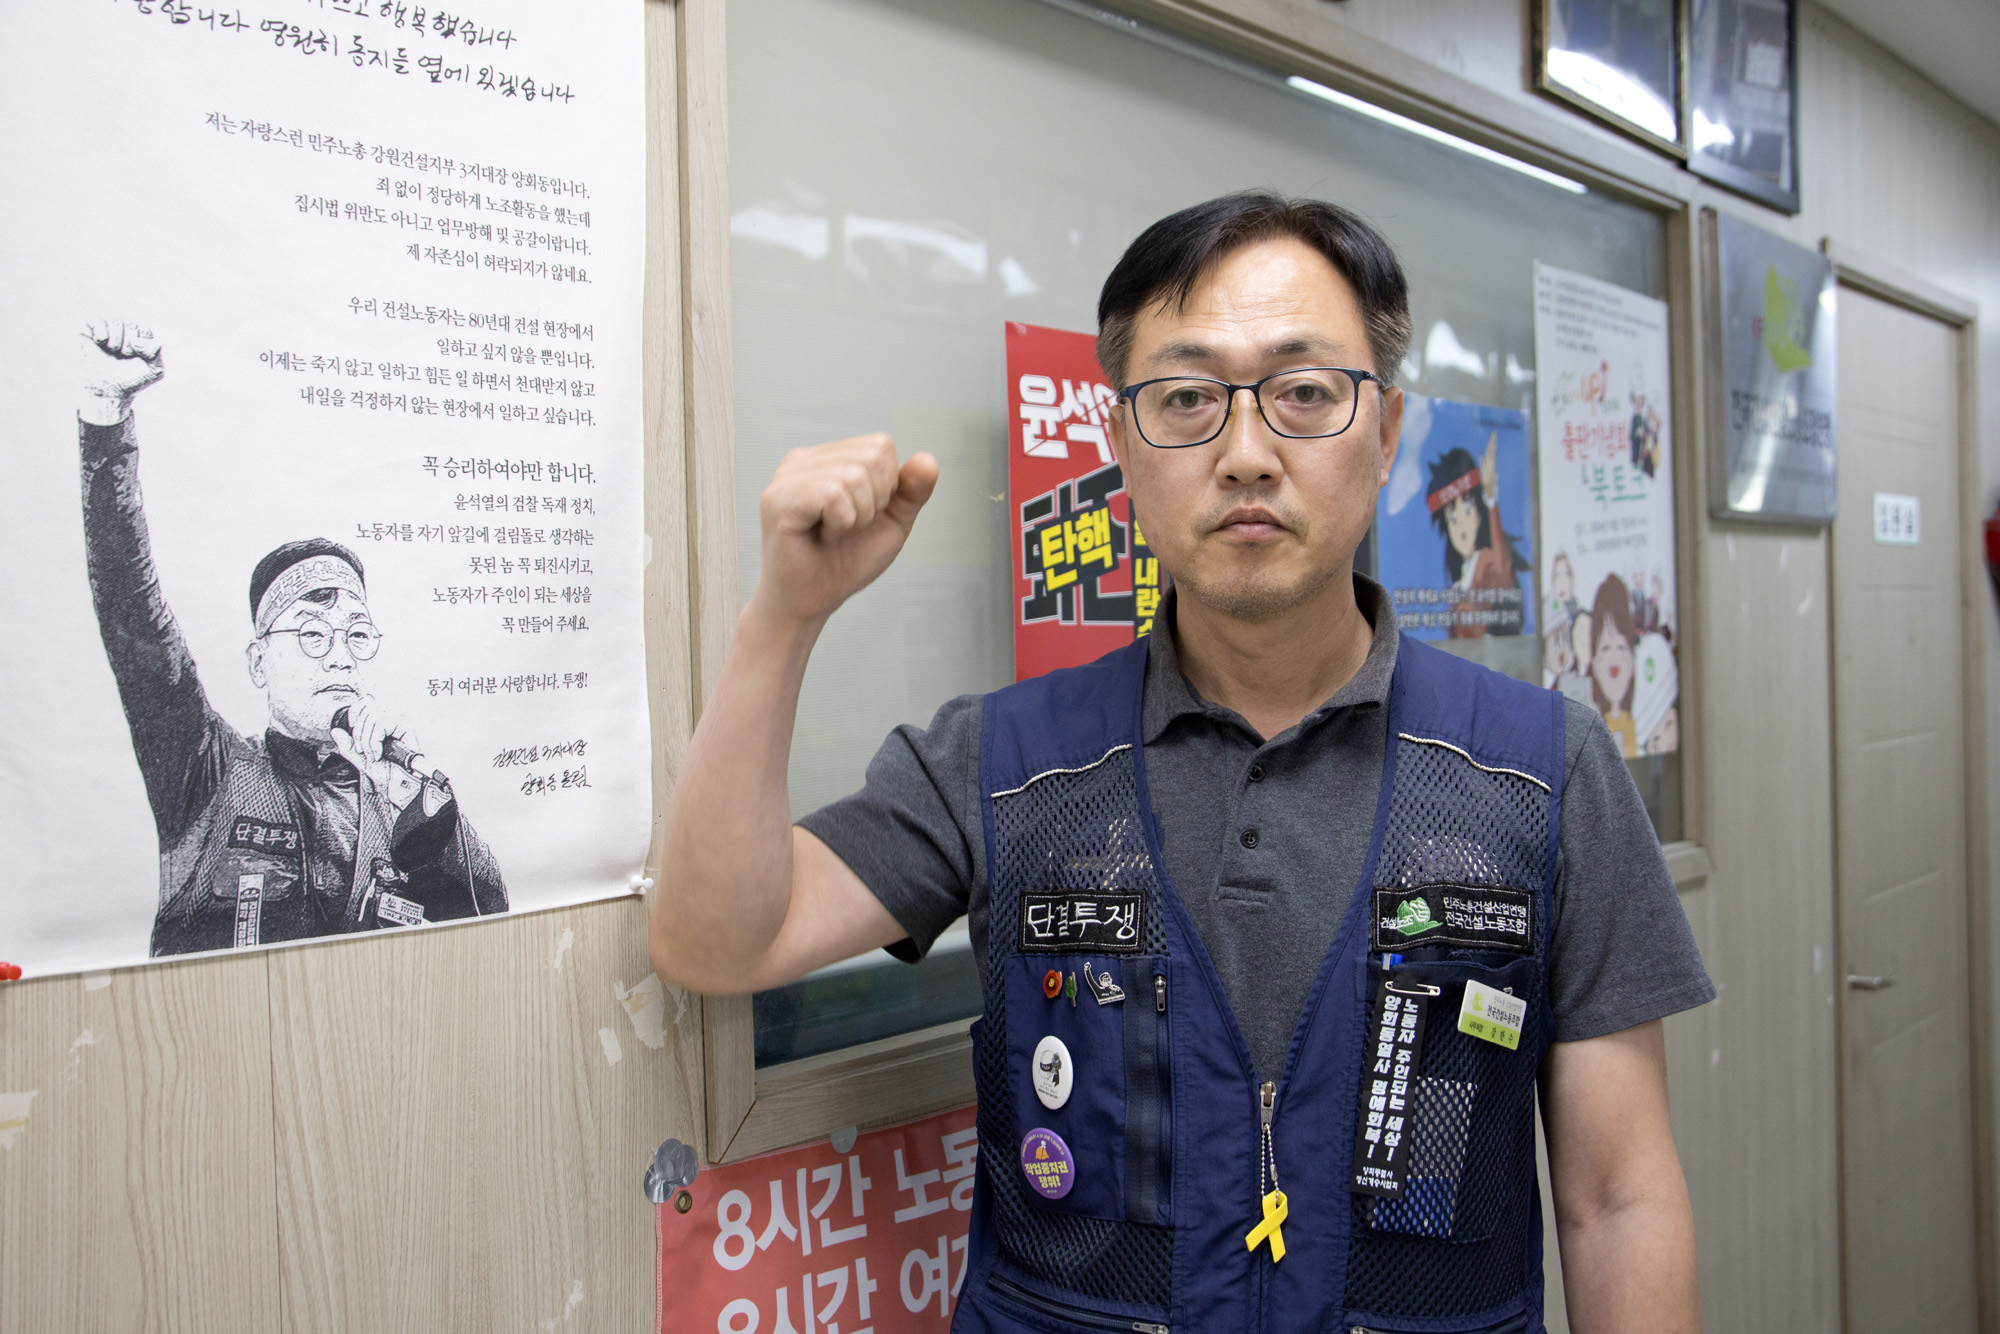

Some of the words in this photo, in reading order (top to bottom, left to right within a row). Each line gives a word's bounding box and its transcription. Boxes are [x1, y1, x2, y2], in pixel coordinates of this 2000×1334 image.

[260, 19, 338, 56] 영원히
[347, 35, 409, 74] 동지들
[418, 55, 469, 83] 옆에
[205, 112, 238, 134] 저는
[241, 119, 303, 148] 자랑스런
[308, 133, 367, 160] 민주노총
[370, 146, 456, 175] 강원건설지부
[459, 163, 509, 185] 3지대장
[511, 170, 590, 199] 양회동입니다.
[376, 177, 389, 195] 죄
[395, 179, 421, 200] 없이
[427, 186, 481, 210] 정당하게
[485, 196, 551, 221] 노조활동을
[554, 207, 590, 228] 했는데
[294, 194, 339, 218] 집시법
[344, 202, 388, 223] 위반도
[391, 210, 434, 231] 아니고
[437, 217, 492, 241] 업무방해
[496, 226, 509, 244] 및
[512, 229, 592, 255] 공갈이랍니다.
[406, 243, 419, 261] 제
[424, 245, 479, 269] 자존심이
[483, 253, 548, 279] 허락되지가
[551, 263, 592, 284] 않네요.
[347, 296, 377, 317] 우리
[382, 300, 466, 327] 건설노동자는
[468, 312, 510, 333] 80년대
[514, 317, 539, 336] 건설
[543, 320, 593, 341] 현장에서
[259, 349, 306, 372] 이제는
[310, 355, 340, 375] 죽지
[344, 358, 374, 378] 않고
[378, 362, 421, 381] 일하고
[425, 366, 452, 386] 힘든
[455, 370, 468, 387] 일
[472, 372, 511, 392] 하면서
[515, 375, 566, 396] 천대받지
[570, 380, 596, 398] 않고
[437, 338, 478, 357] 일하고
[481, 343, 506, 361] 싶지
[510, 346, 537, 365] 않을
[540, 349, 595, 370] 뿐입니다.
[300, 385, 346, 407] 내일을
[350, 390, 406, 413] 걱정하지
[411, 396, 439, 415] 않는
[443, 399, 494, 420] 현장에서
[499, 404, 540, 422] 일하고
[543, 407, 596, 427] 싶습니다.
[422, 456, 439, 477] 꼭
[443, 457, 543, 482] 승리하여야만
[547, 462, 596, 485] 합니다.
[454, 494, 508, 512] 윤석열의
[512, 495, 538, 513] 검찰
[542, 497, 567, 514] 독재
[571, 498, 596, 516] 정치,
[356, 523, 414, 542] 노동자를
[417, 524, 444, 543] 자기
[448, 526, 489, 544] 앞길에
[493, 527, 546, 544] 걸림돌로
[549, 528, 594, 546] 생각하는
[1040, 506, 1113, 591] 탄핵
[469, 556, 496, 574] 못된
[500, 557, 515, 574] 놈
[517, 558, 531, 574] 꼭
[534, 557, 593, 575] 퇴진시키고,
[433, 586, 488, 604] 노동자가
[491, 586, 530, 604] 주인이
[534, 587, 558, 604] 되는
[560, 586, 592, 603] 세상을
[502, 616, 515, 633] 꼭
[518, 616, 553, 633] 만들어
[556, 615, 590, 632] 주세요.
[427, 678, 454, 696] 동지
[458, 676, 498, 695] 여러분
[500, 673, 560, 693] 사랑합니다.
[562, 671, 588, 689] 투쟁!
[236, 822, 298, 849] 단결투쟁
[1027, 900, 1136, 939] 단결투쟁
[1380, 914, 1414, 930] 건설노조
[1373, 995, 1401, 1074] 양회동열사
[1397, 998, 1419, 1045] 노동자
[1389, 1048, 1413, 1111] 주인되는
[1364, 1079, 1389, 1159] 명예회복!
[1384, 1115, 1404, 1162] 세상!
[1024, 1160, 1069, 1176] 작업중지권
[1038, 1175, 1061, 1189] 쟁취!
[713, 1155, 872, 1271] 8시간
